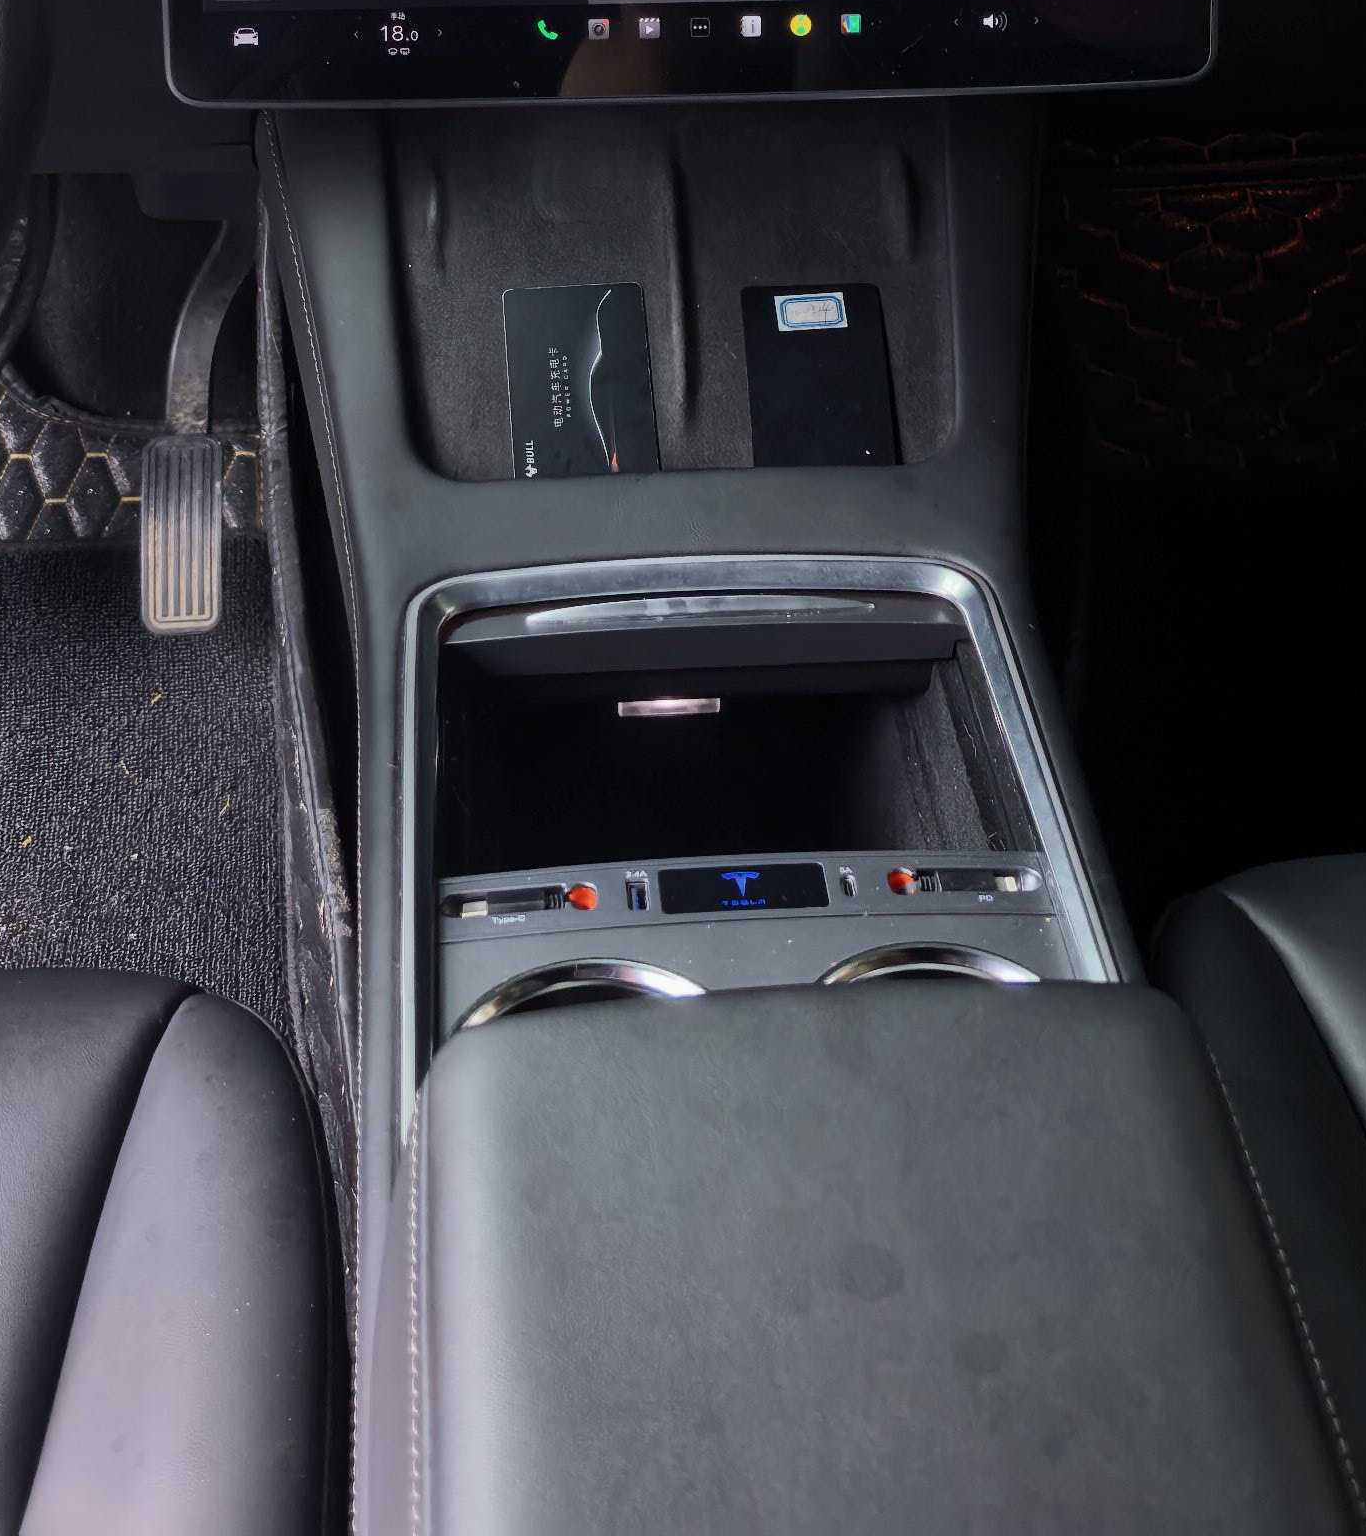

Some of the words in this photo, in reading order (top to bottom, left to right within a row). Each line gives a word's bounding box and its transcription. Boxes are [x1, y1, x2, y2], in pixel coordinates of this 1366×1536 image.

[379, 25, 419, 42] 18.0
[547, 347, 564, 428] 电动汽车充电卡
[525, 440, 535, 464] BULL
